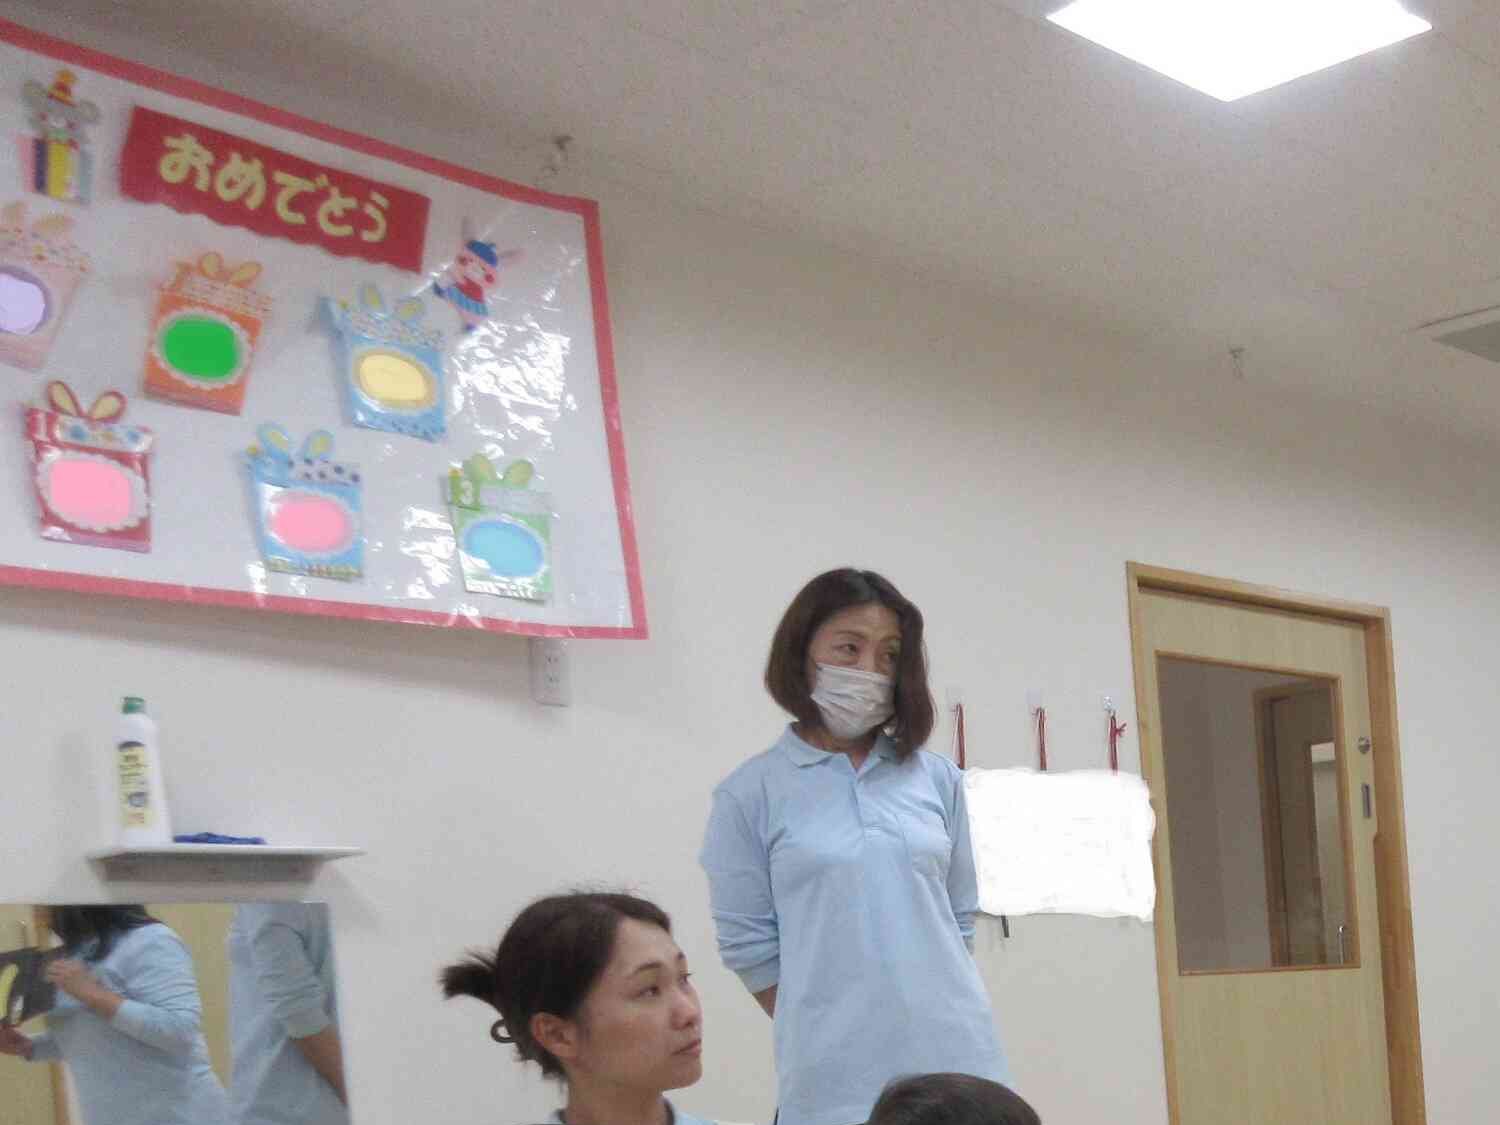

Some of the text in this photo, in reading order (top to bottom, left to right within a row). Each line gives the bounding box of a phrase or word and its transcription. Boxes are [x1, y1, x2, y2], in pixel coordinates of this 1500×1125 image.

[160, 133, 390, 243] おめでとう
